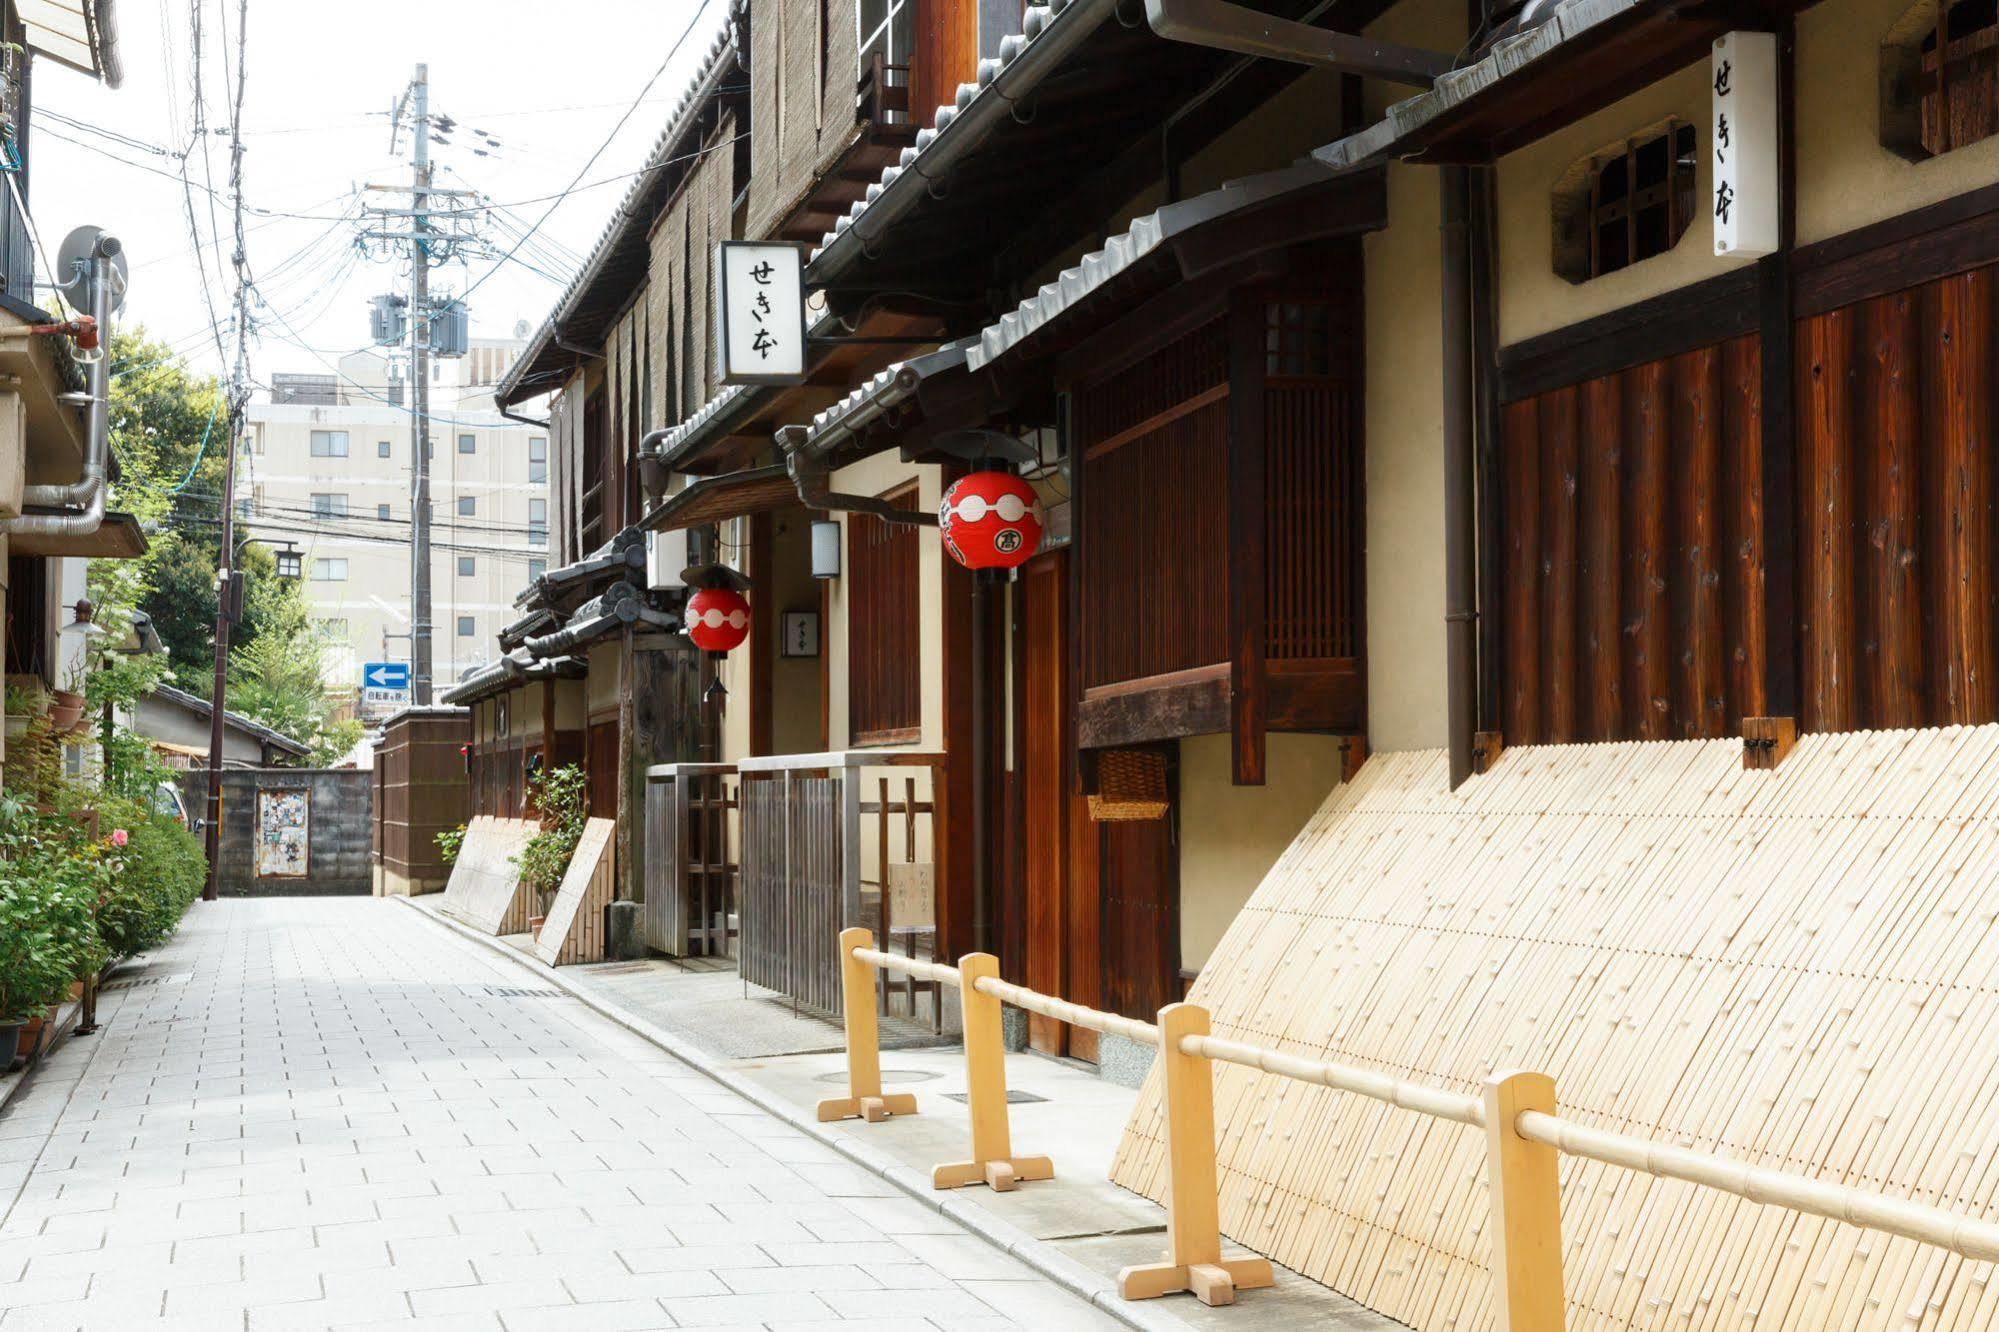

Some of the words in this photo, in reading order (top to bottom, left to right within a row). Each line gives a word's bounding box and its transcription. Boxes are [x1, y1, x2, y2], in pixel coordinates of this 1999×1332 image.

[1714, 59, 1734, 225] せき本
[748, 260, 779, 360] せき本
